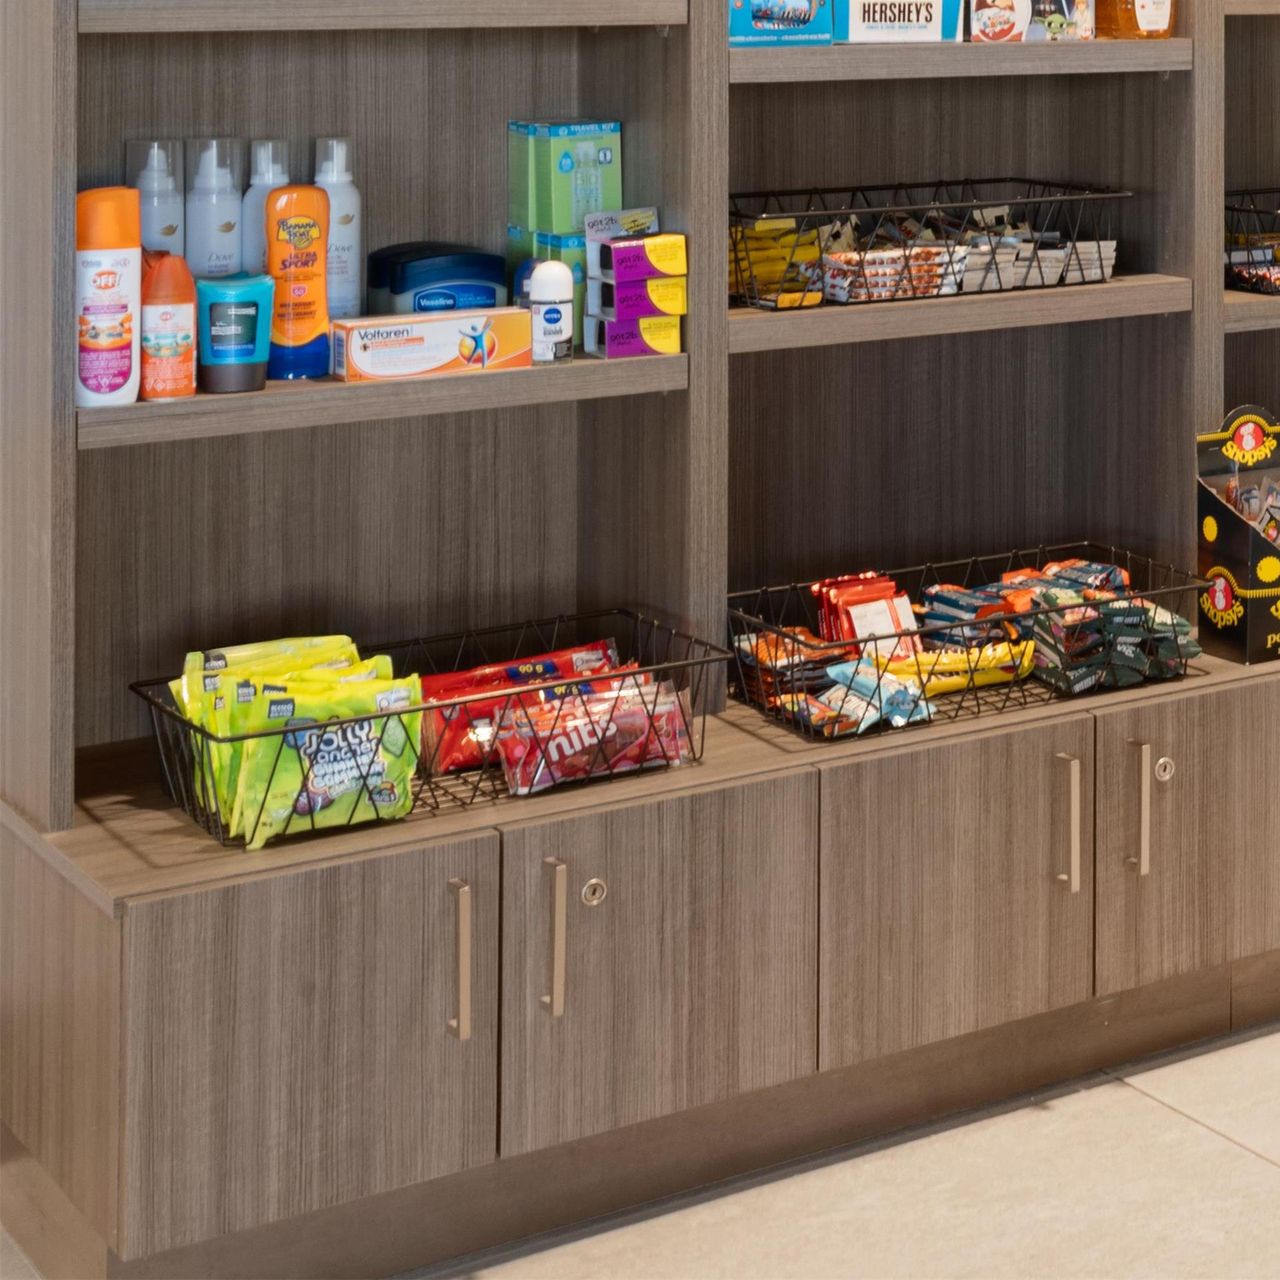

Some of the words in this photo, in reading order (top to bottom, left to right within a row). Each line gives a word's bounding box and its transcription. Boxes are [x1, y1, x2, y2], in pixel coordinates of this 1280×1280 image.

[862, 2, 934, 23] HERSHEY'S
[303, 721, 372, 757] JOLLY
[312, 738, 378, 766] ancher
[548, 717, 618, 762] nibs
